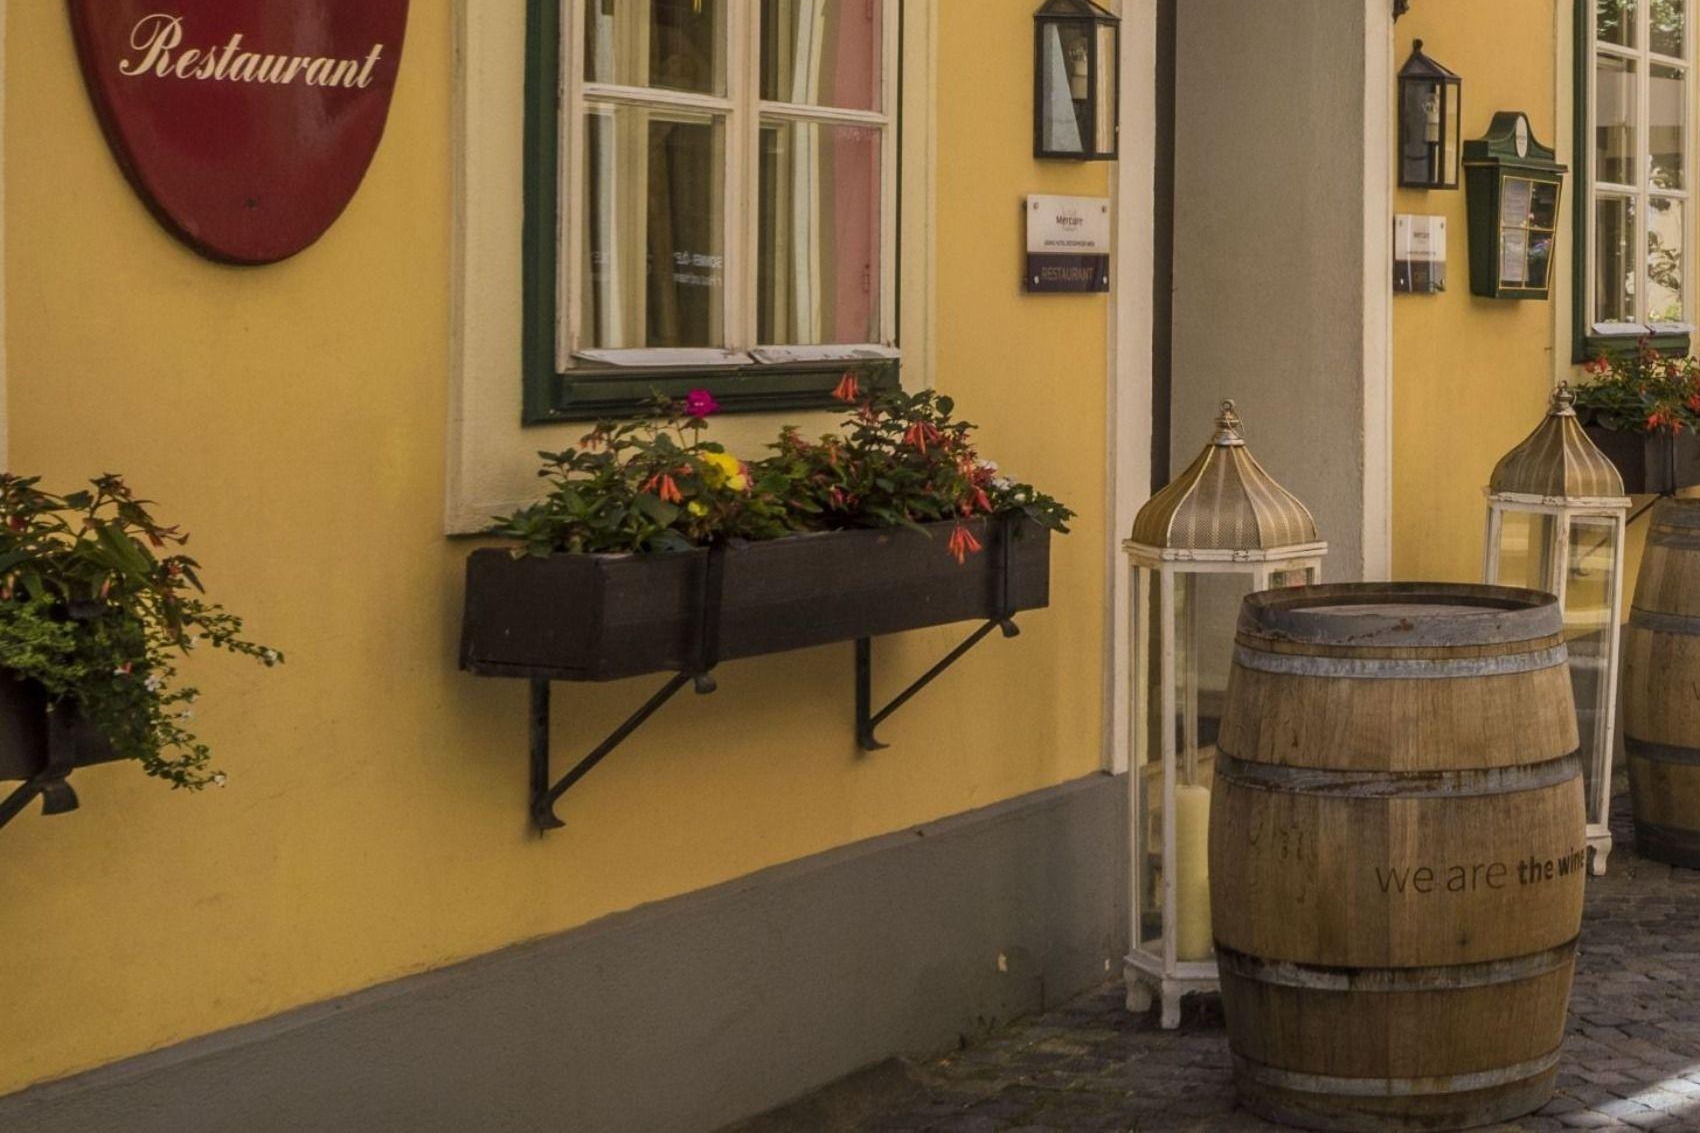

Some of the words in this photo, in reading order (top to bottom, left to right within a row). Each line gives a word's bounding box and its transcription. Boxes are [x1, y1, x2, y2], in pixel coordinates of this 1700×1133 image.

[119, 12, 384, 90] Restaurant
[1375, 866, 1434, 894] we
[1446, 862, 1508, 893] are
[1518, 856, 1554, 885] the
